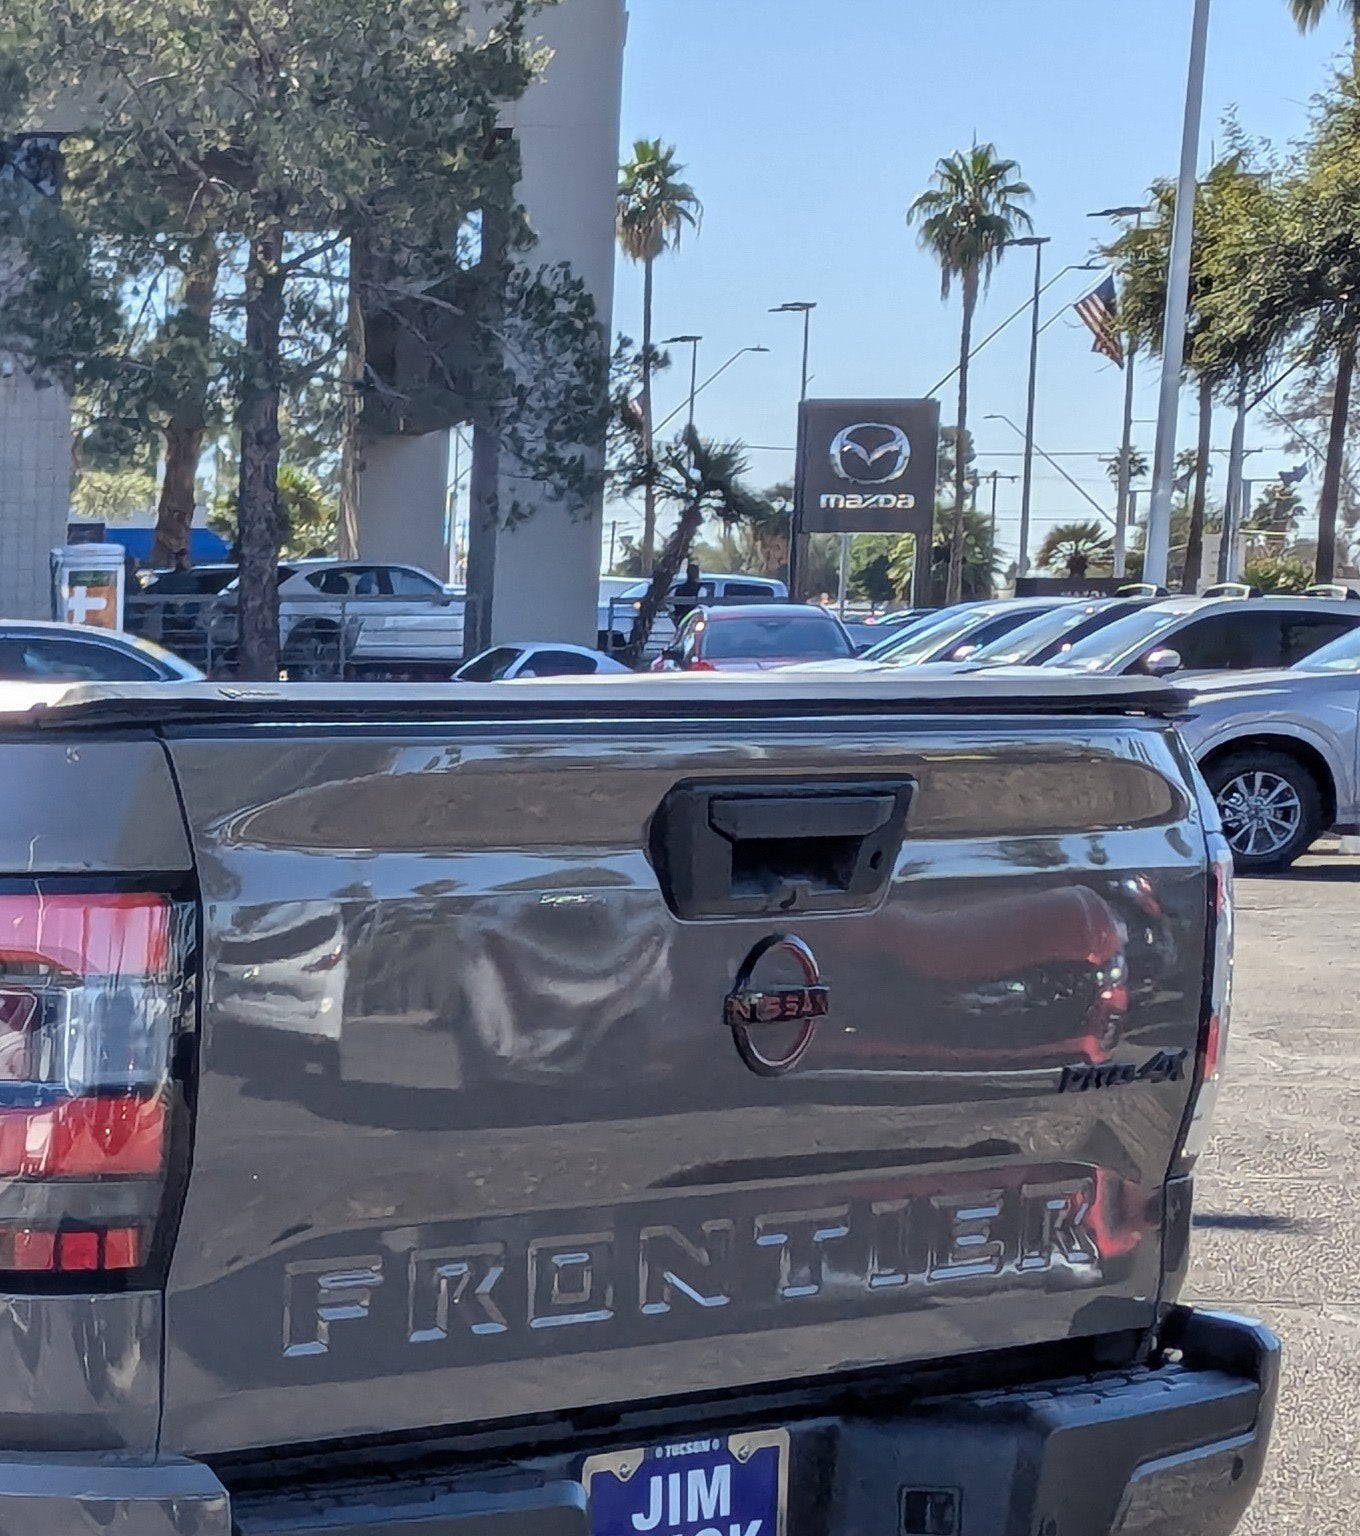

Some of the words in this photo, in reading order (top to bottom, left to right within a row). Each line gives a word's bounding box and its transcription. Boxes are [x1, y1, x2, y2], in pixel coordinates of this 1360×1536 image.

[819, 493, 916, 509] mazda
[283, 1176, 1102, 1358] FRONTIER
[631, 1464, 731, 1531] JIM
